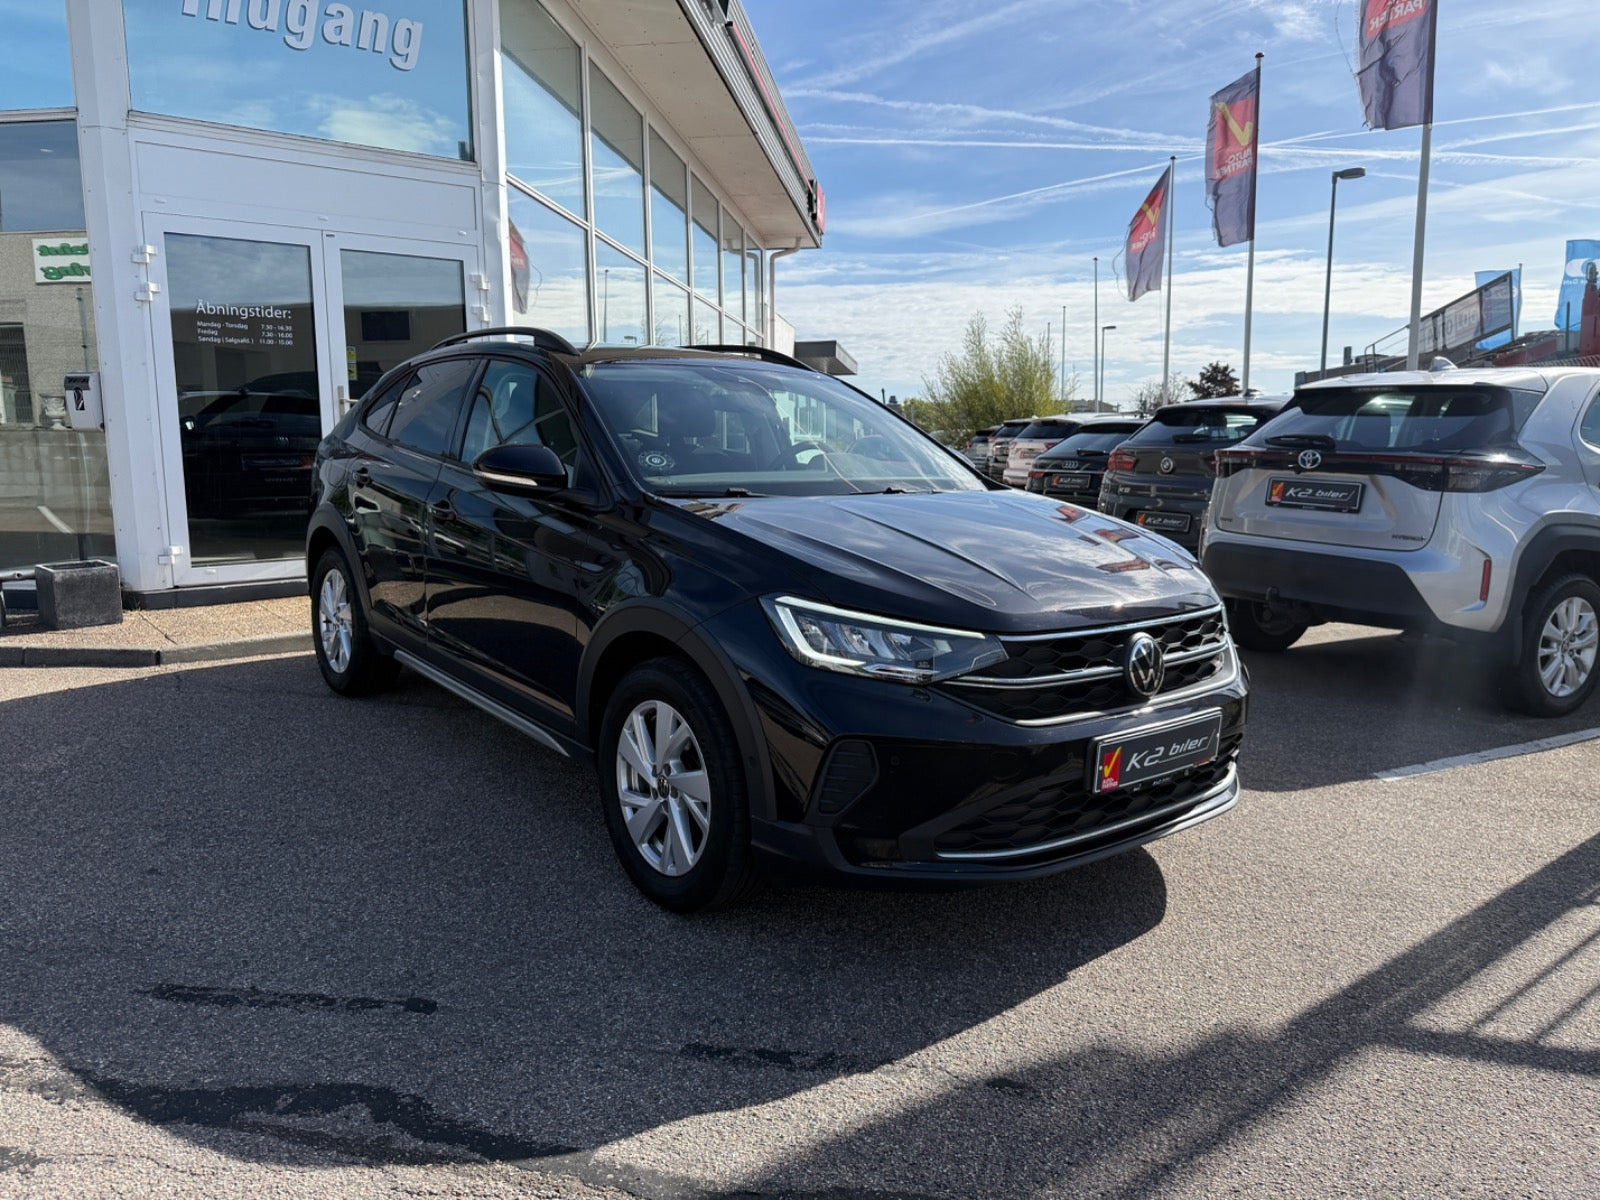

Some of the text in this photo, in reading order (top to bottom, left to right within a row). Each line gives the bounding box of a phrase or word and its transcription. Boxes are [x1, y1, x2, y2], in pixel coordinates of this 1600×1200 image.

[182, 0, 424, 71] ndgang
[196, 299, 292, 319] Åbningstider:
[1285, 487, 1313, 498] K2
[1315, 489, 1349, 499] biler
[1126, 736, 1209, 772] K2 biler
